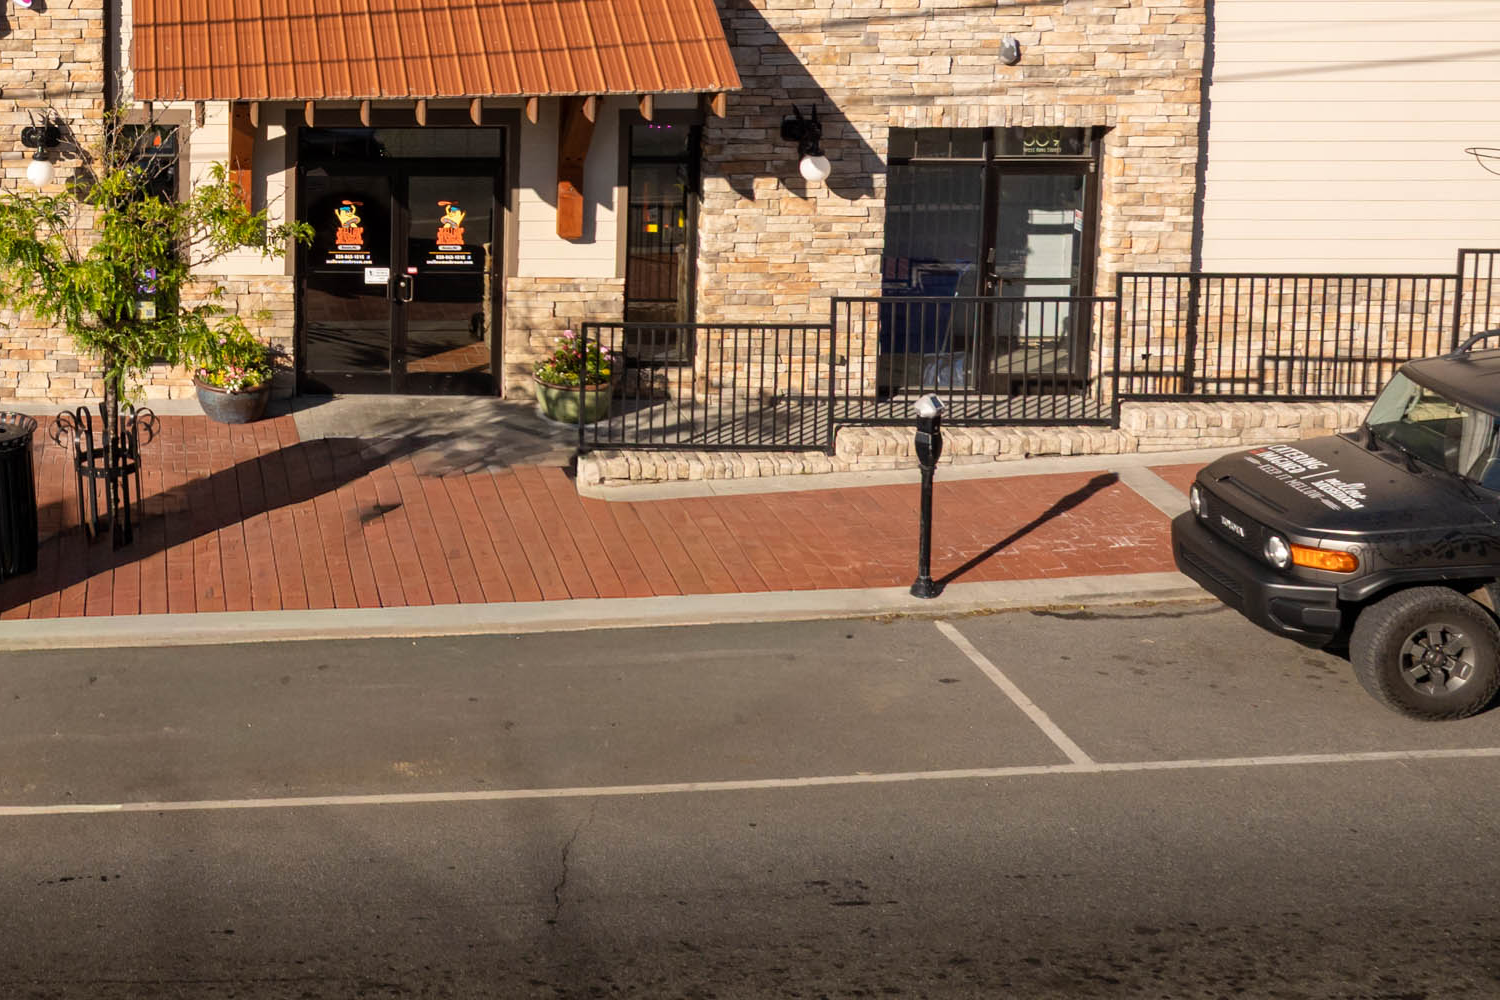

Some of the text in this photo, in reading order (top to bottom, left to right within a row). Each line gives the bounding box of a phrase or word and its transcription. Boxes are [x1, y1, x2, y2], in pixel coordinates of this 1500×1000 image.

[1268, 444, 1328, 470] CATERING
[1257, 463, 1325, 499] KEEP IT MELLOW
